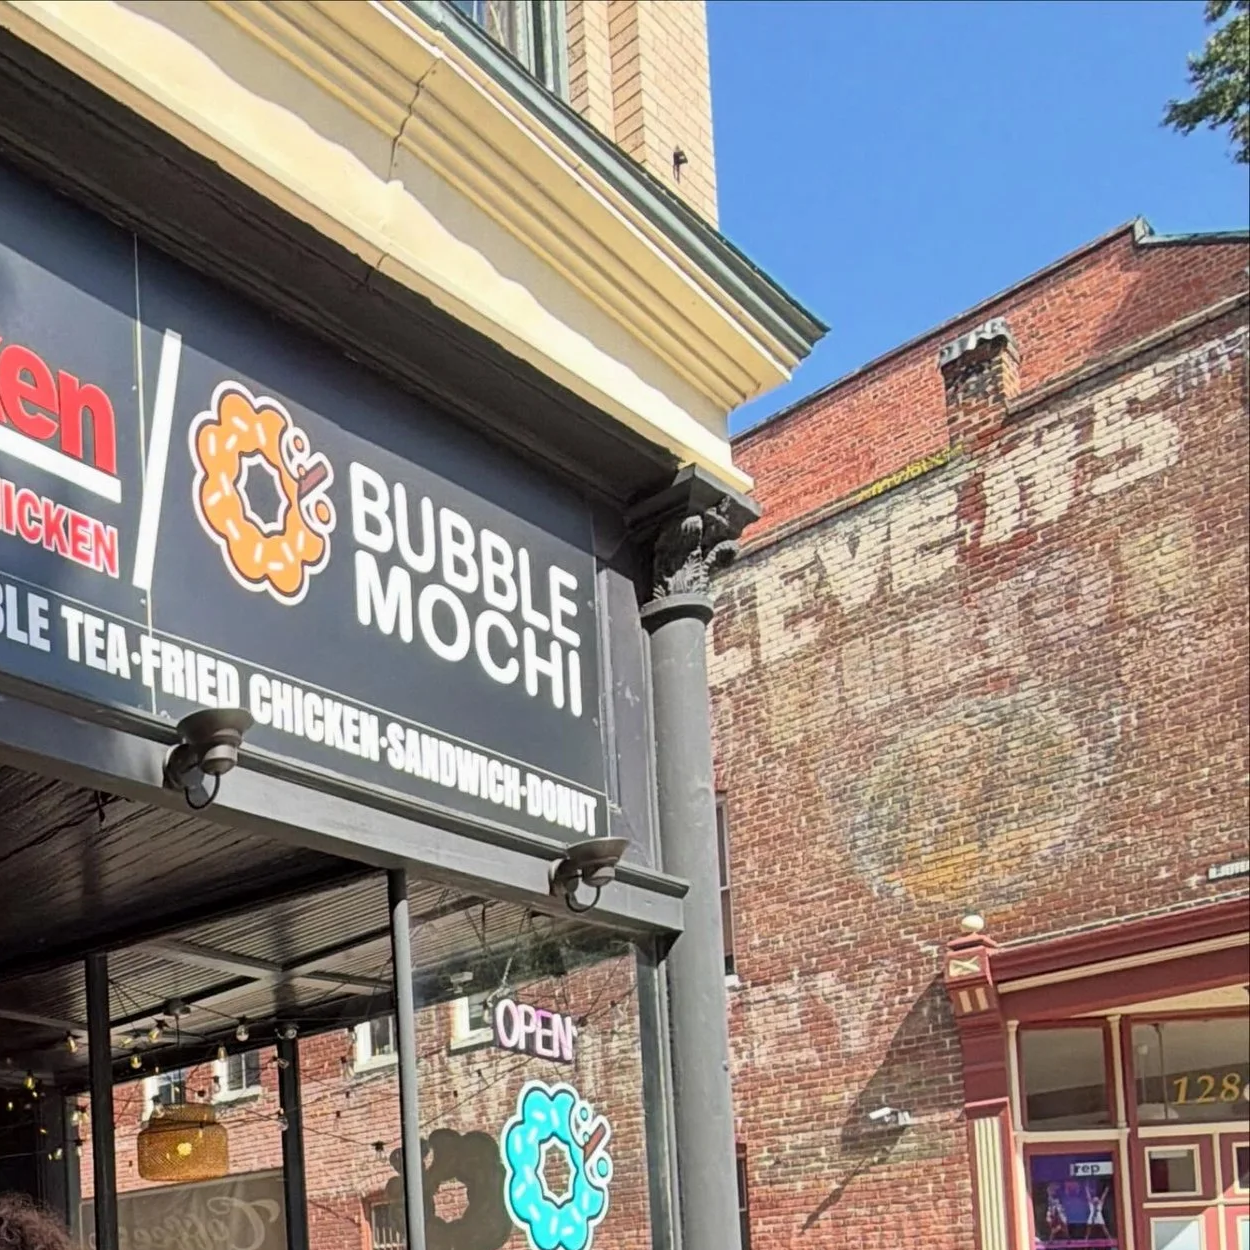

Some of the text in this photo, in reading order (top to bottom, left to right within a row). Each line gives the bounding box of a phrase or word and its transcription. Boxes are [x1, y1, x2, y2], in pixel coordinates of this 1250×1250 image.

[350, 460, 581, 648] BUBBLE
[355, 550, 584, 718] MOCHI
[495, 999, 573, 1061] OPEN
[1172, 1073, 1241, 1105] 128
[1074, 1163, 1100, 1176] rep
